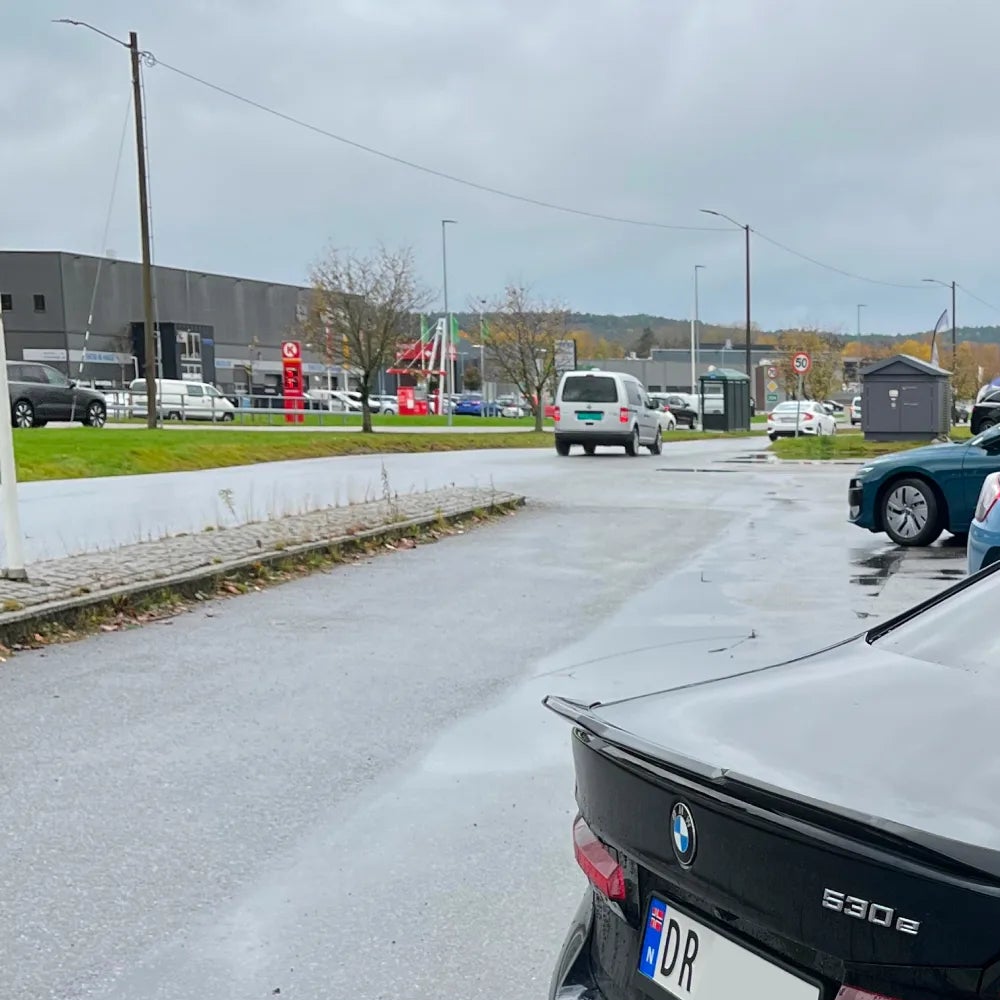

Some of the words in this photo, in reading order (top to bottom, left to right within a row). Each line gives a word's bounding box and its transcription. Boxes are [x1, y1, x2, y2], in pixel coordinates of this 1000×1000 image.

[794, 357, 807, 369] 50
[671, 804, 692, 828] BMW
[646, 946, 655, 966] N
[660, 918, 700, 993] DR
